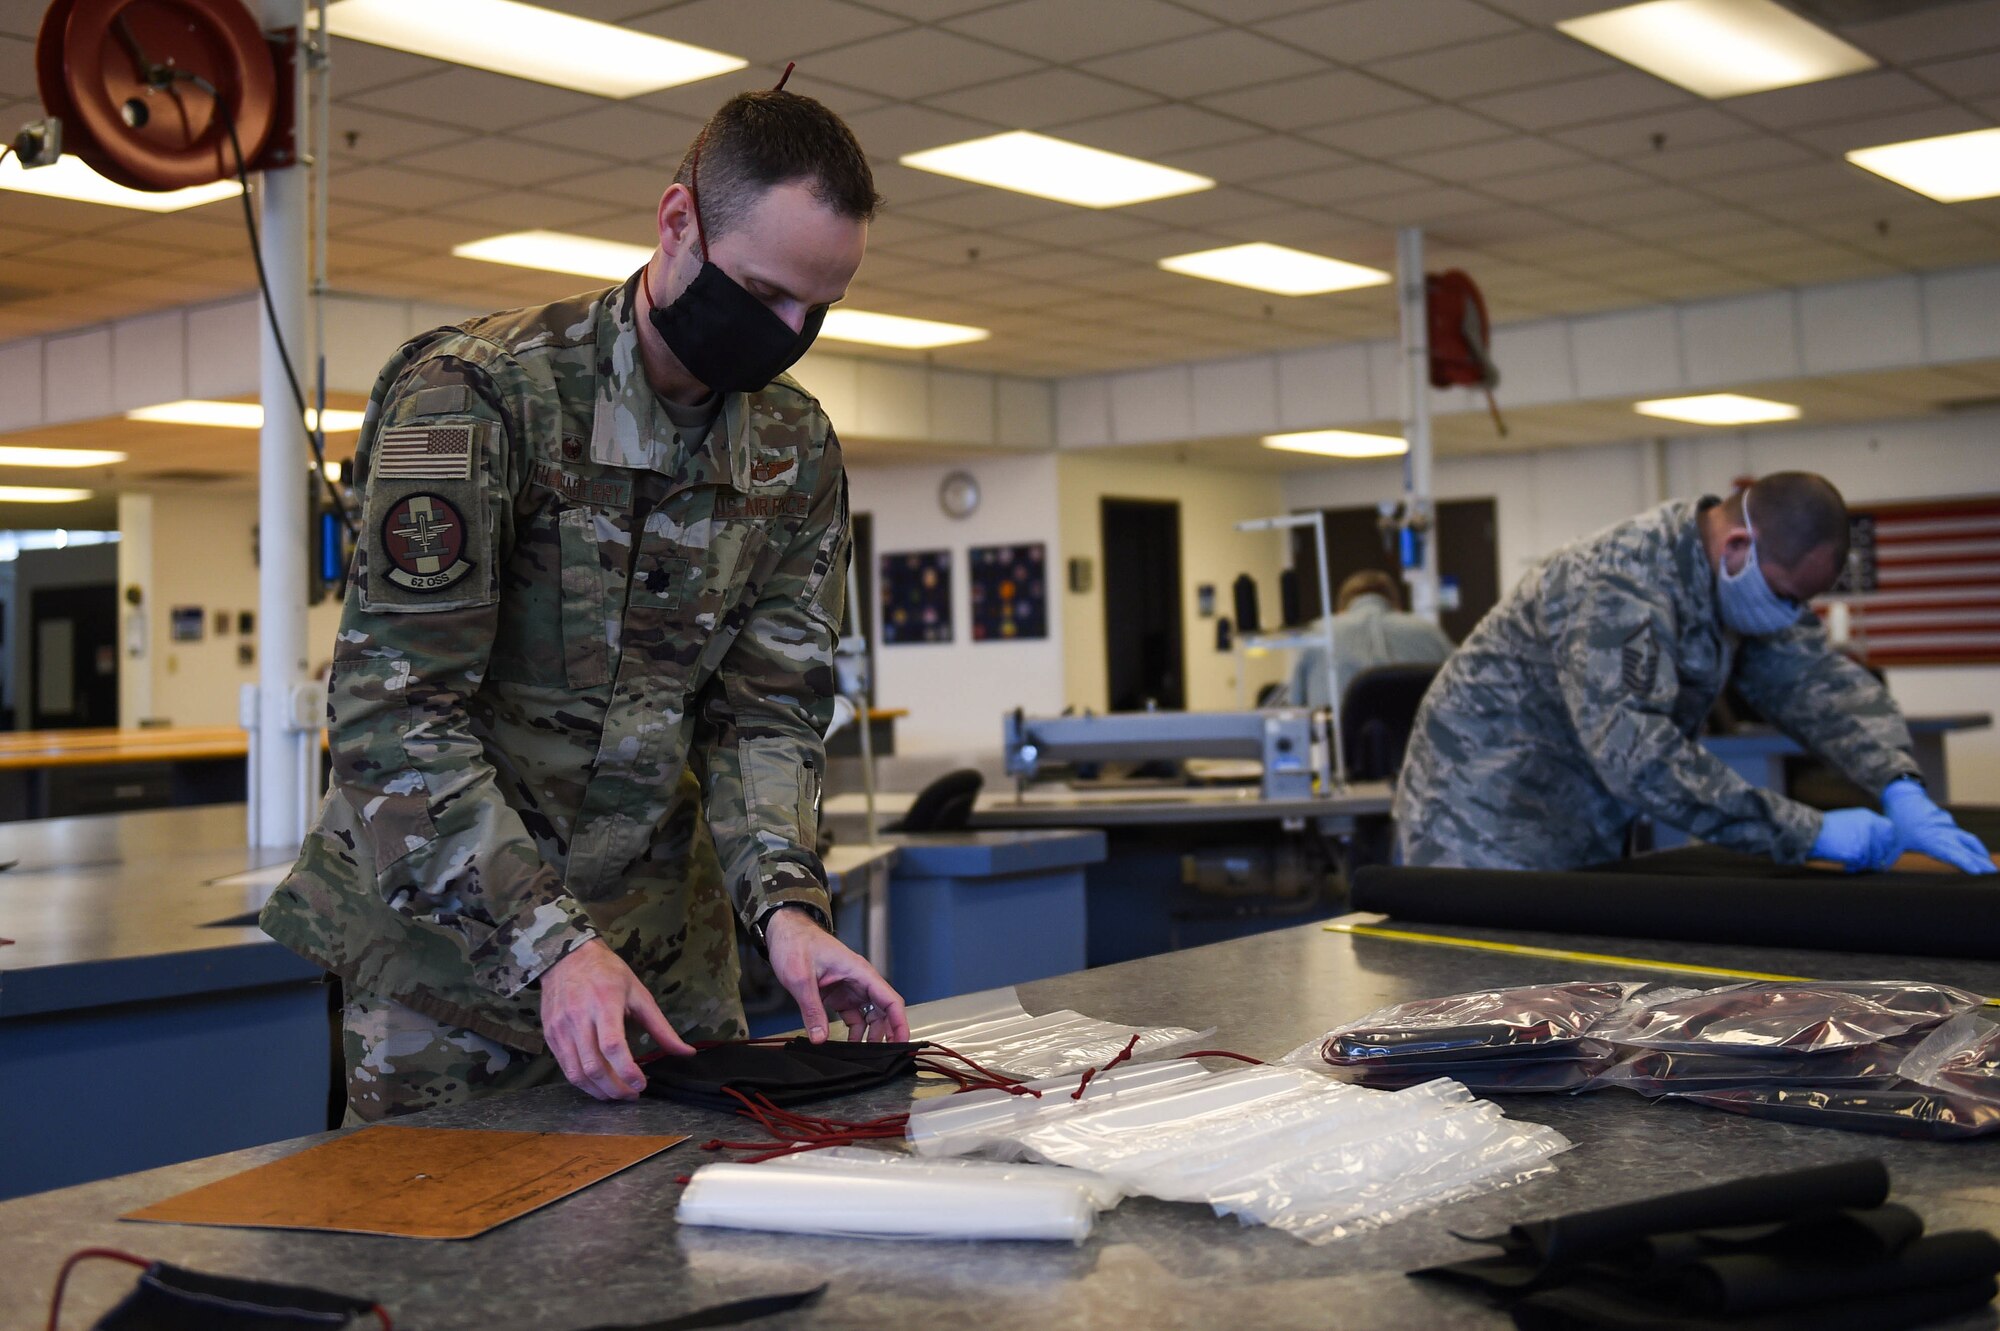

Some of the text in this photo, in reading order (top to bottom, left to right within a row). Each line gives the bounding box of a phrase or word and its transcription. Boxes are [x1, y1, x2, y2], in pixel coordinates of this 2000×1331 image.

[744, 496, 768, 516] AIR
[772, 494, 808, 514] FRCE
[411, 573, 450, 587] 62 OSS
